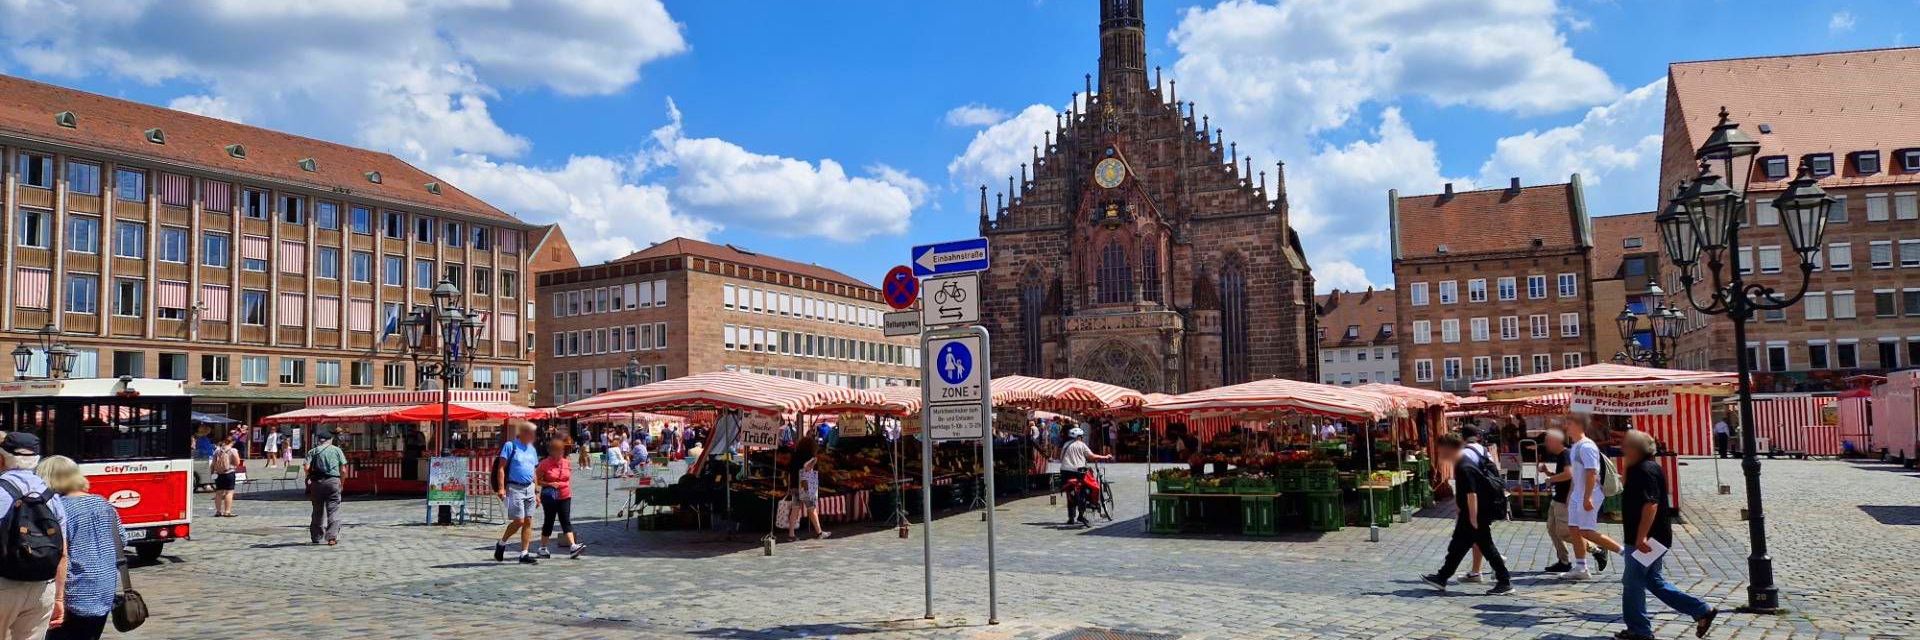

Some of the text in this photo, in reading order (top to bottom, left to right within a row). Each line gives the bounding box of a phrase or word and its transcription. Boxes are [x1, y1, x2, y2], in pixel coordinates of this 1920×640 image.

[933, 250, 984, 263] Einbahnstraße
[886, 320, 919, 329] Rettungsweg
[942, 386, 969, 398] ZONE
[1574, 386, 1669, 399] Fränkische Beeren
[1596, 397, 1668, 407] Prichsenstadt
[743, 430, 777, 445] Trüffel
[105, 464, 148, 473] CityTrain
